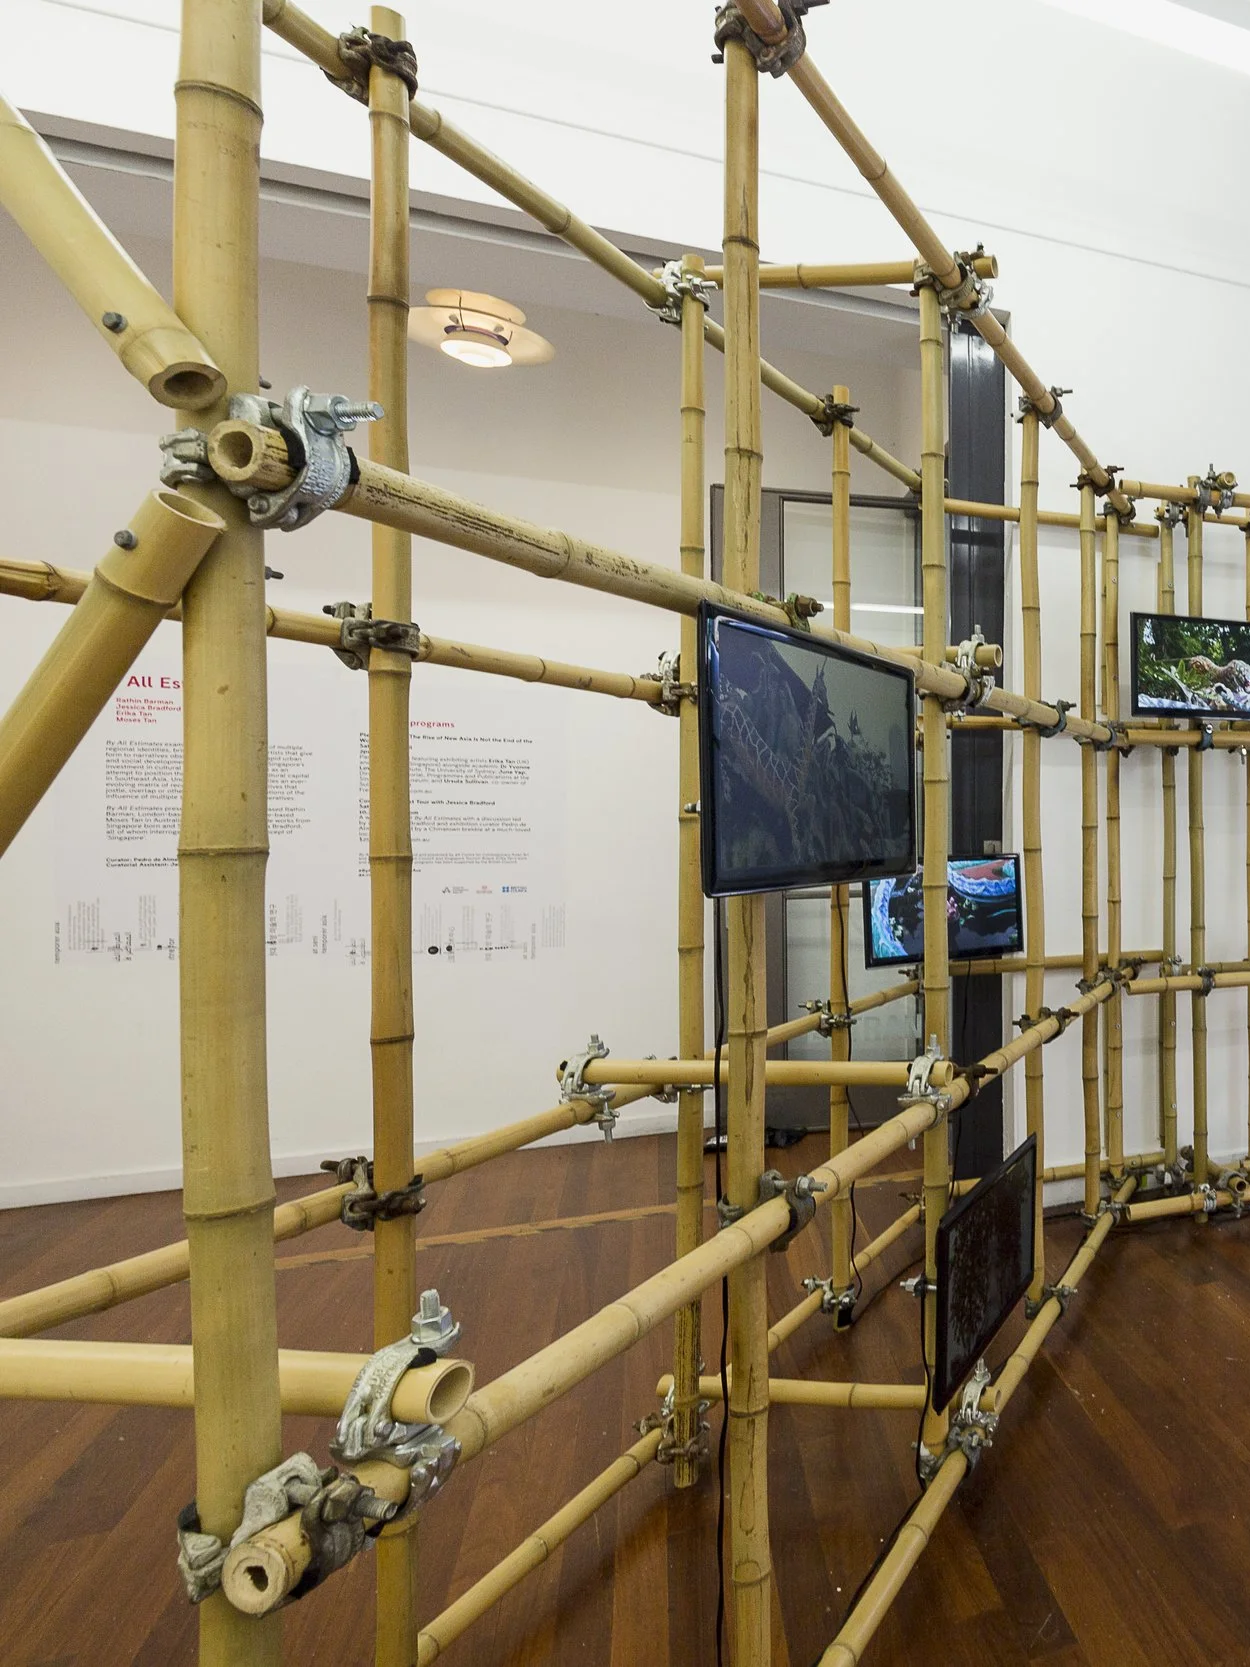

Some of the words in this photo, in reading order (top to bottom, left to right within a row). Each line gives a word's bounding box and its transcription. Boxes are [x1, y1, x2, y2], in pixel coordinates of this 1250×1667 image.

[127, 676, 153, 688] All
[160, 677, 183, 690] Es
[409, 720, 455, 729] programs
